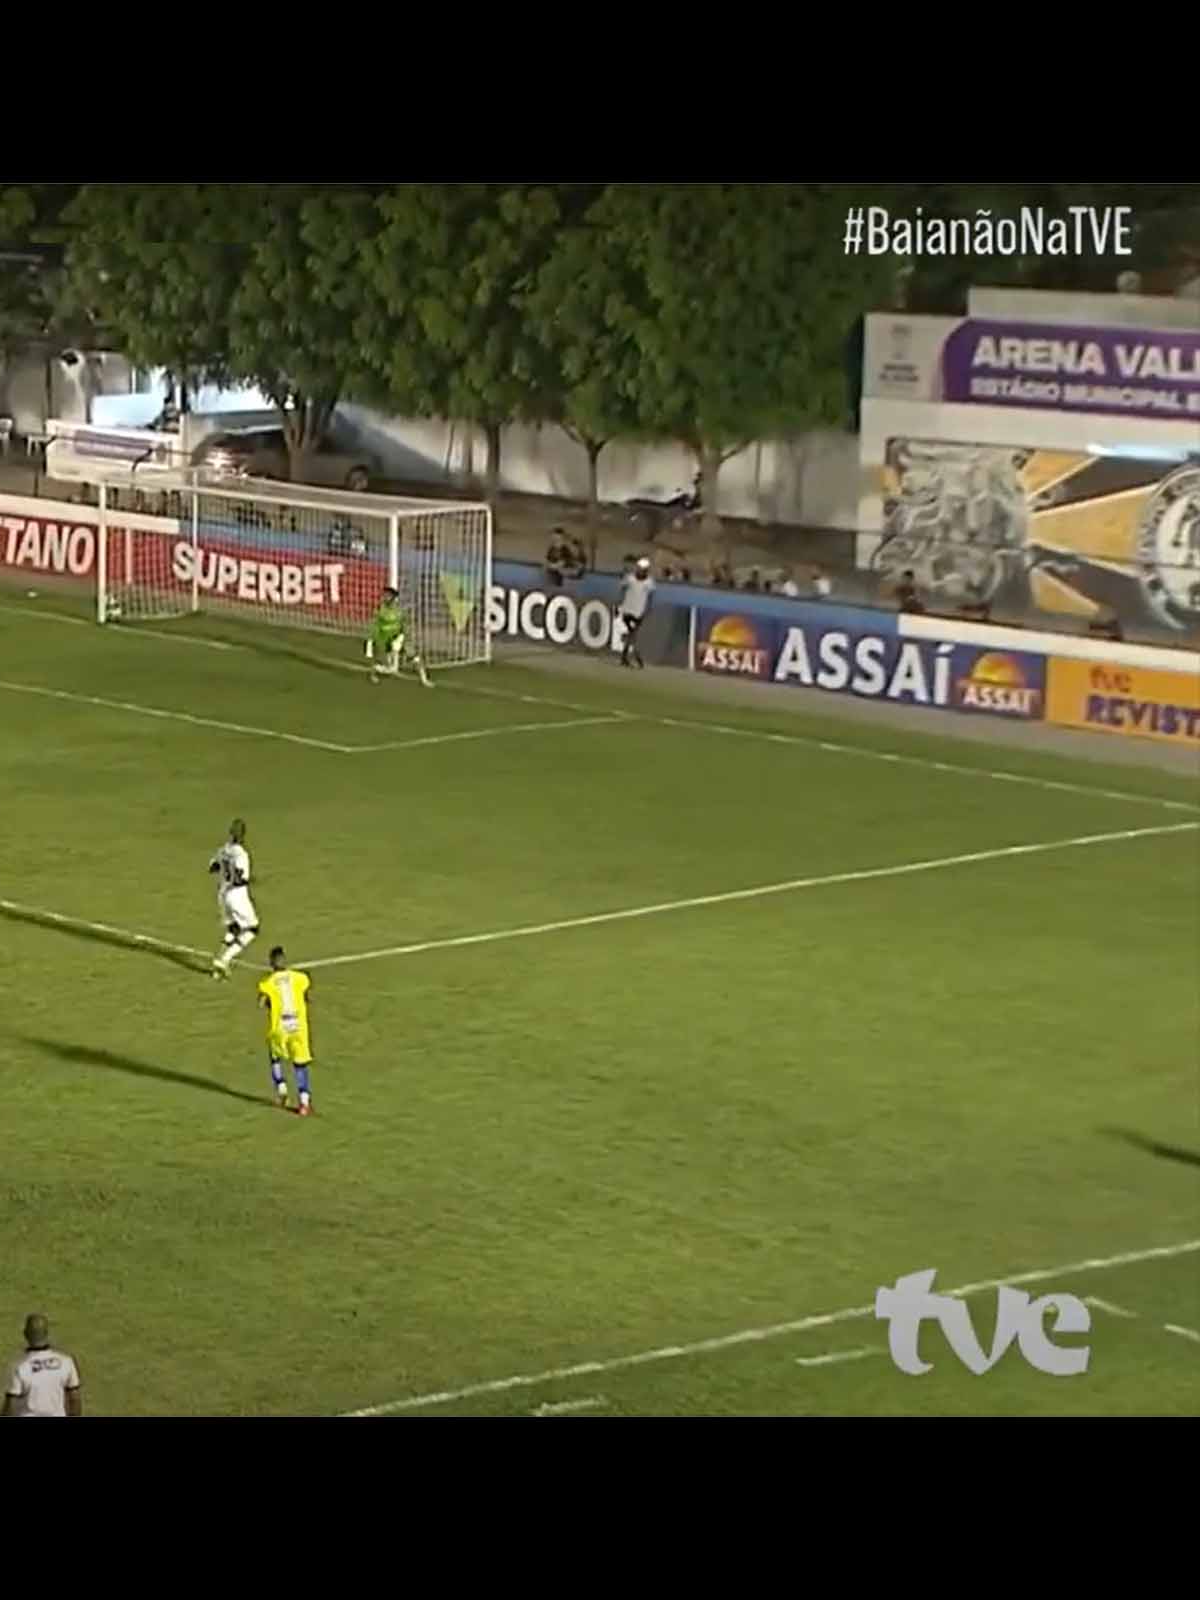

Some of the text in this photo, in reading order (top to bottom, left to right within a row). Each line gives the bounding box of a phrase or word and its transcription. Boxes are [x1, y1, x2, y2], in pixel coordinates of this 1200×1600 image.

[972, 336, 1200, 380] ARENA VAL
[172, 541, 345, 604] SUPERBET
[774, 627, 951, 705] ASSAÍ
[1086, 694, 1200, 739] REVIST
